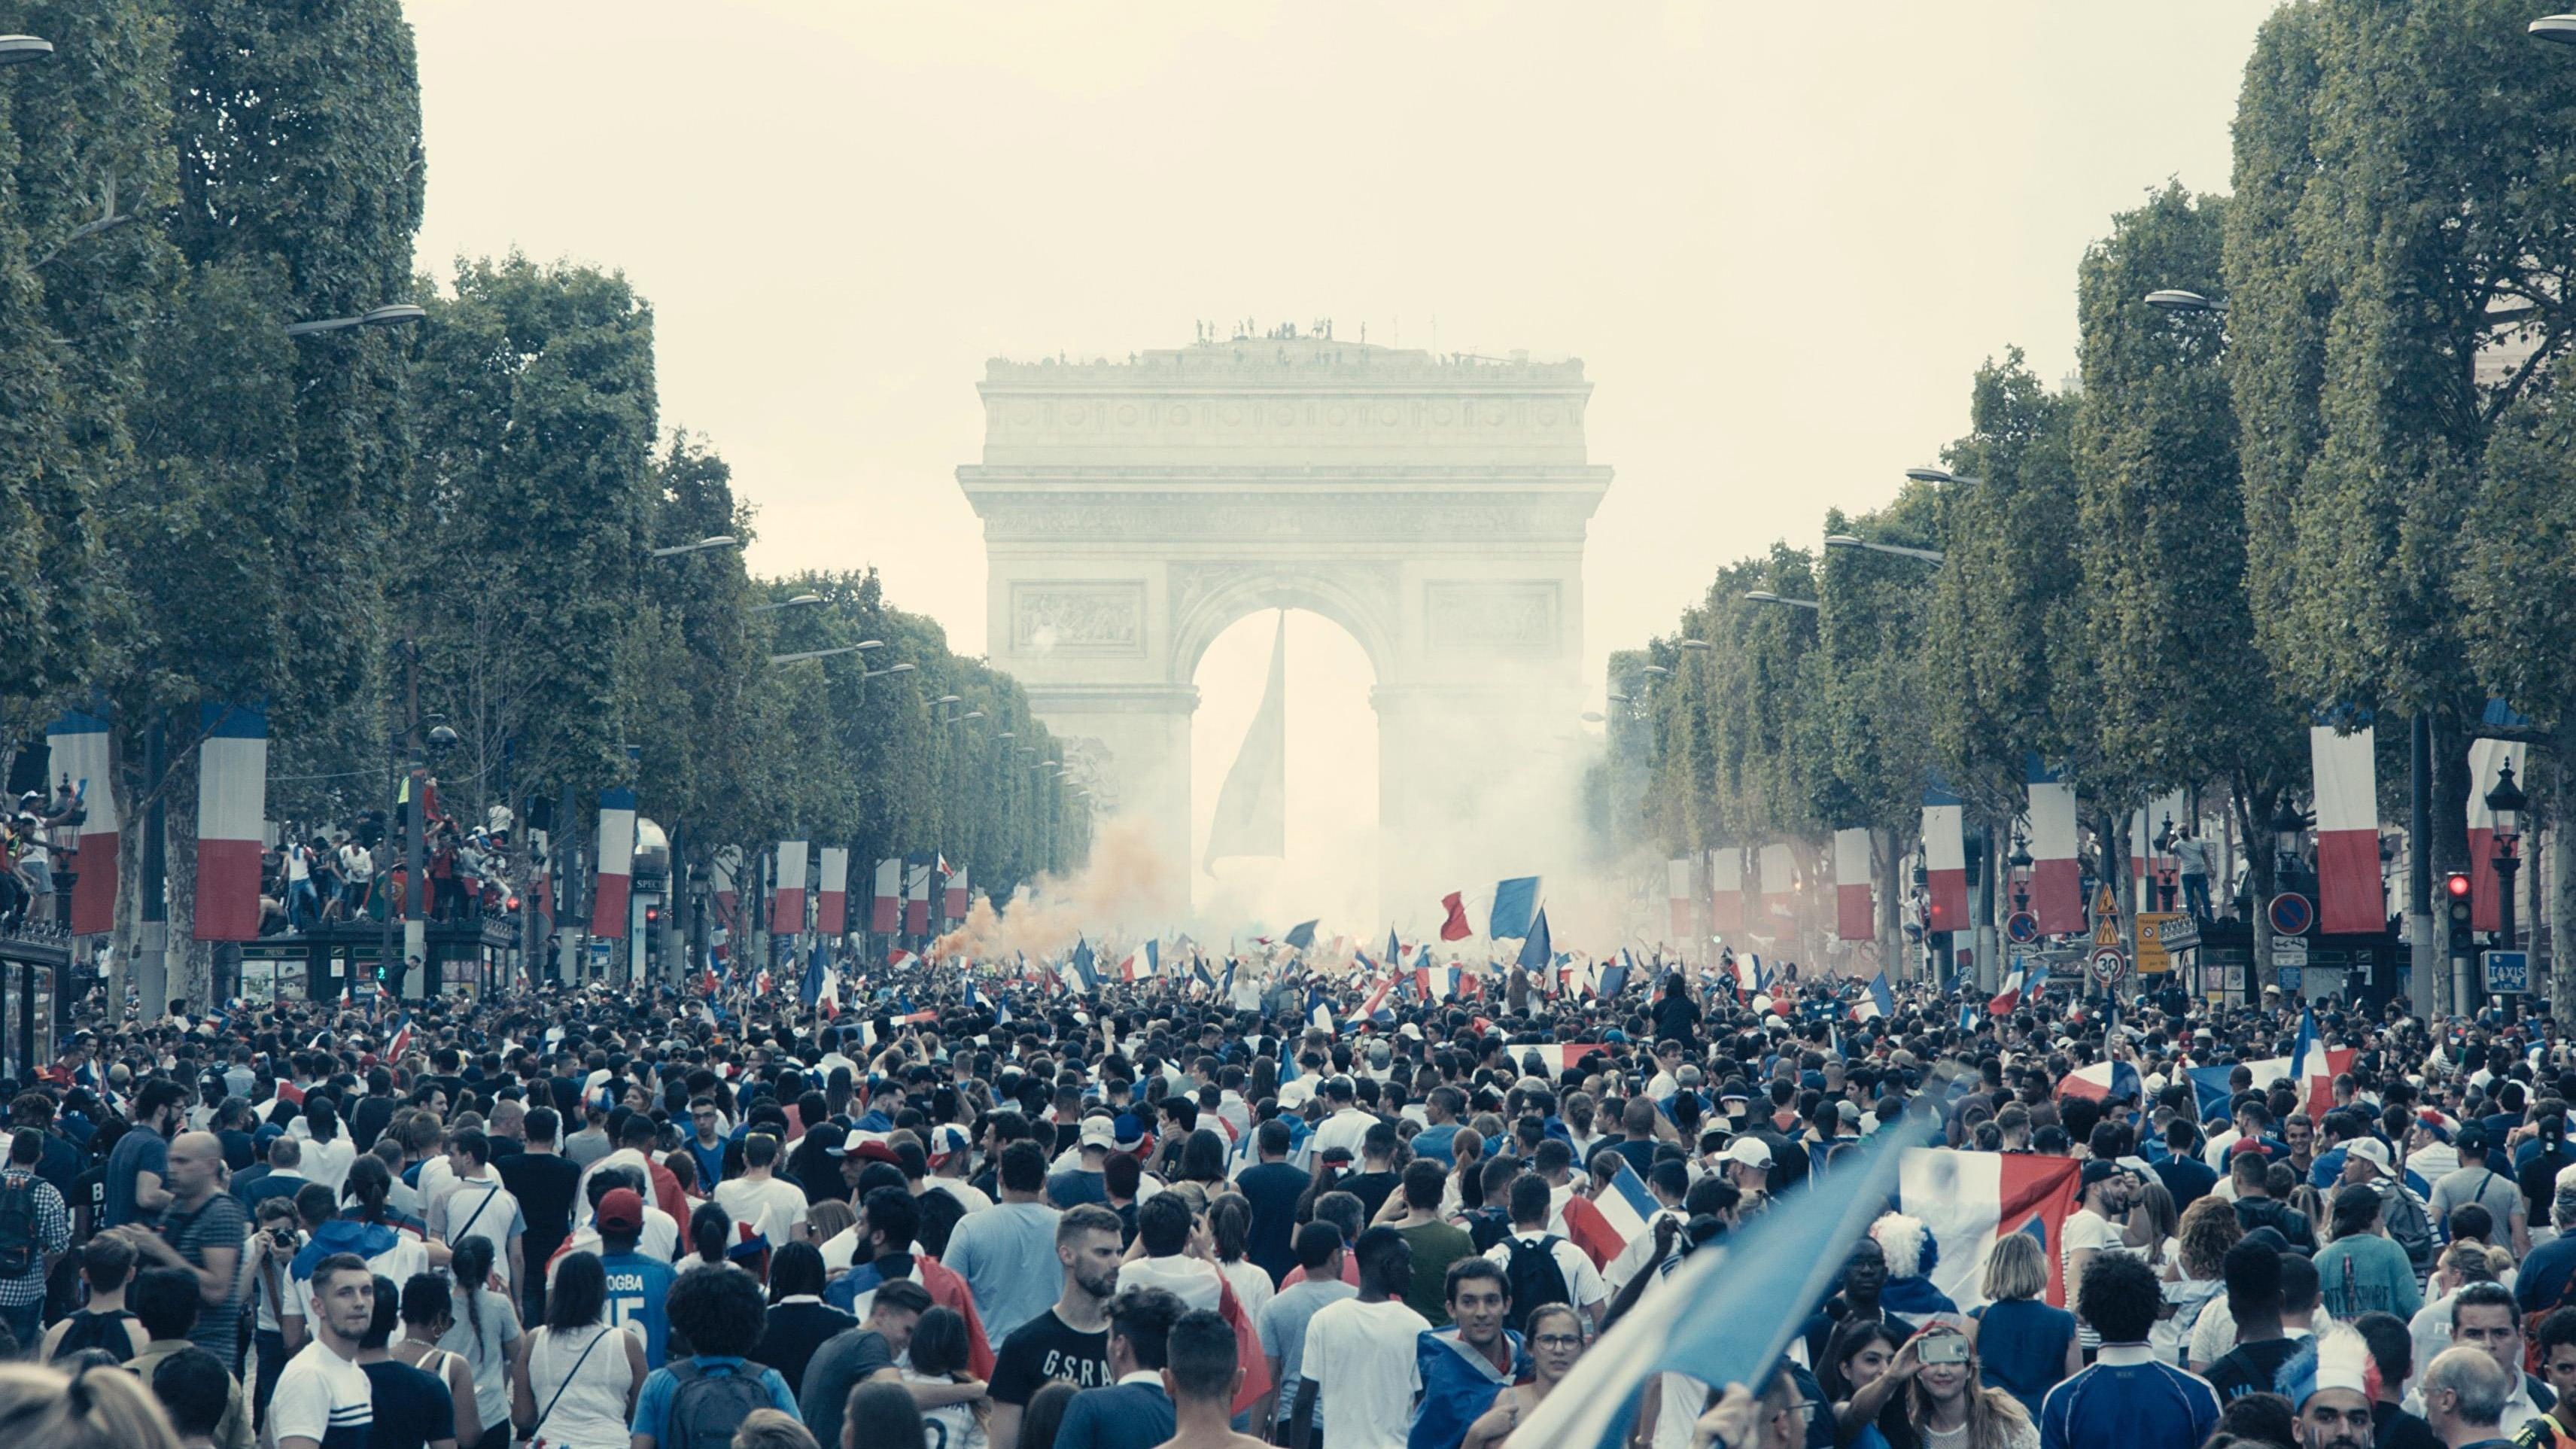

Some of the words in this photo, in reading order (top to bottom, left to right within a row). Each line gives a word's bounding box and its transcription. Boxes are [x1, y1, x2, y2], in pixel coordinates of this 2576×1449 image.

[2098, 958, 2118, 973] 30
[2490, 966, 2526, 982] TAXIS
[606, 1274, 643, 1292] OGBA
